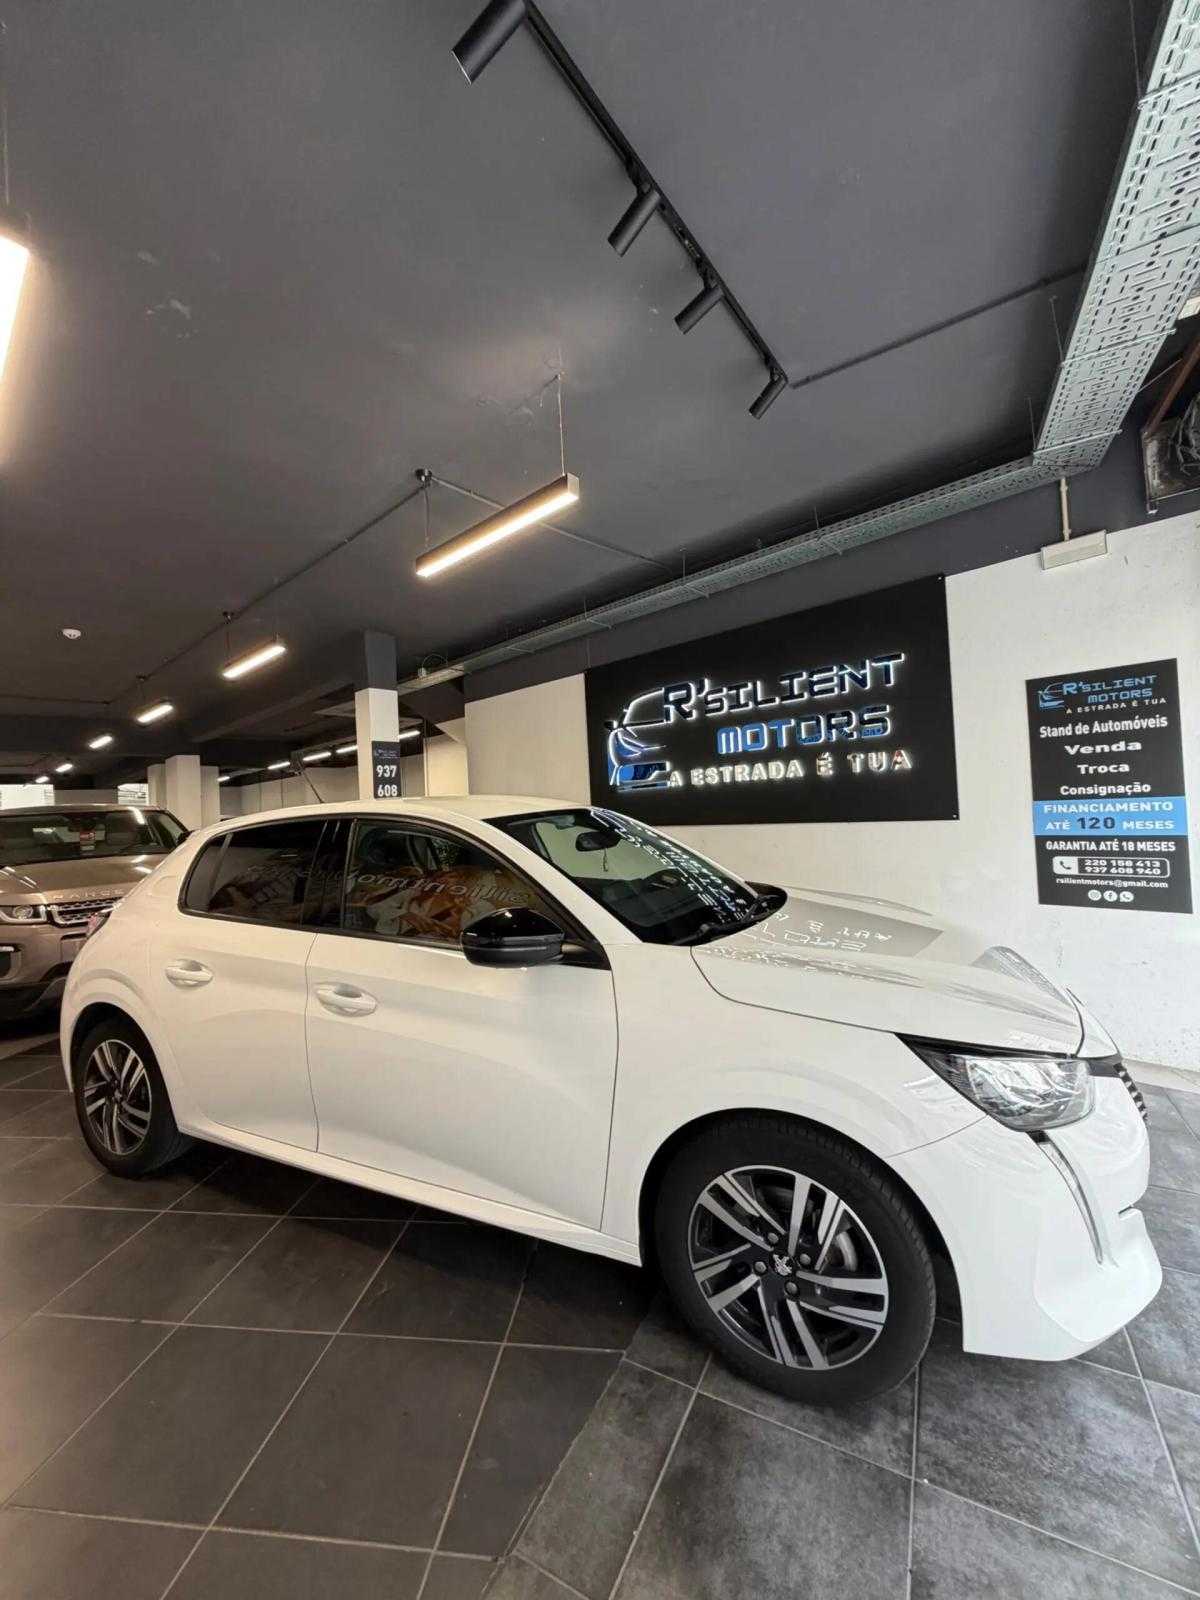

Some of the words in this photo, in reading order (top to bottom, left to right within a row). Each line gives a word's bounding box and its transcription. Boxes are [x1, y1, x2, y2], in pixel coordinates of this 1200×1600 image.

[1087, 688, 1153, 703] MOTORS
[1077, 702, 1127, 713] ESTRADA
[1144, 697, 1166, 706] TUA
[717, 704, 892, 755] MOTORS
[1040, 722, 1073, 739] Stand
[1075, 722, 1090, 736] de
[1093, 715, 1168, 734] Automóveis
[1064, 740, 1142, 755] Venda
[376, 765, 397, 778] 937
[667, 771, 685, 788] A
[690, 759, 805, 786] ESTRADA
[815, 751, 833, 777] É
[847, 749, 913, 774] TUA
[1077, 763, 1131, 775] Troca
[377, 784, 398, 797] 608
[1060, 782, 1152, 796] Consignação
[1043, 801, 1174, 814] FINANCIAMENTO
[1045, 819, 1072, 831] ATÉ
[1077, 817, 1116, 830] 120
[1122, 820, 1175, 831] MESES
[1046, 840, 1097, 852] GARANTIA
[1097, 838, 1120, 851] ATÉ
[1122, 841, 1136, 852] 18
[1137, 841, 1177, 852] MESES
